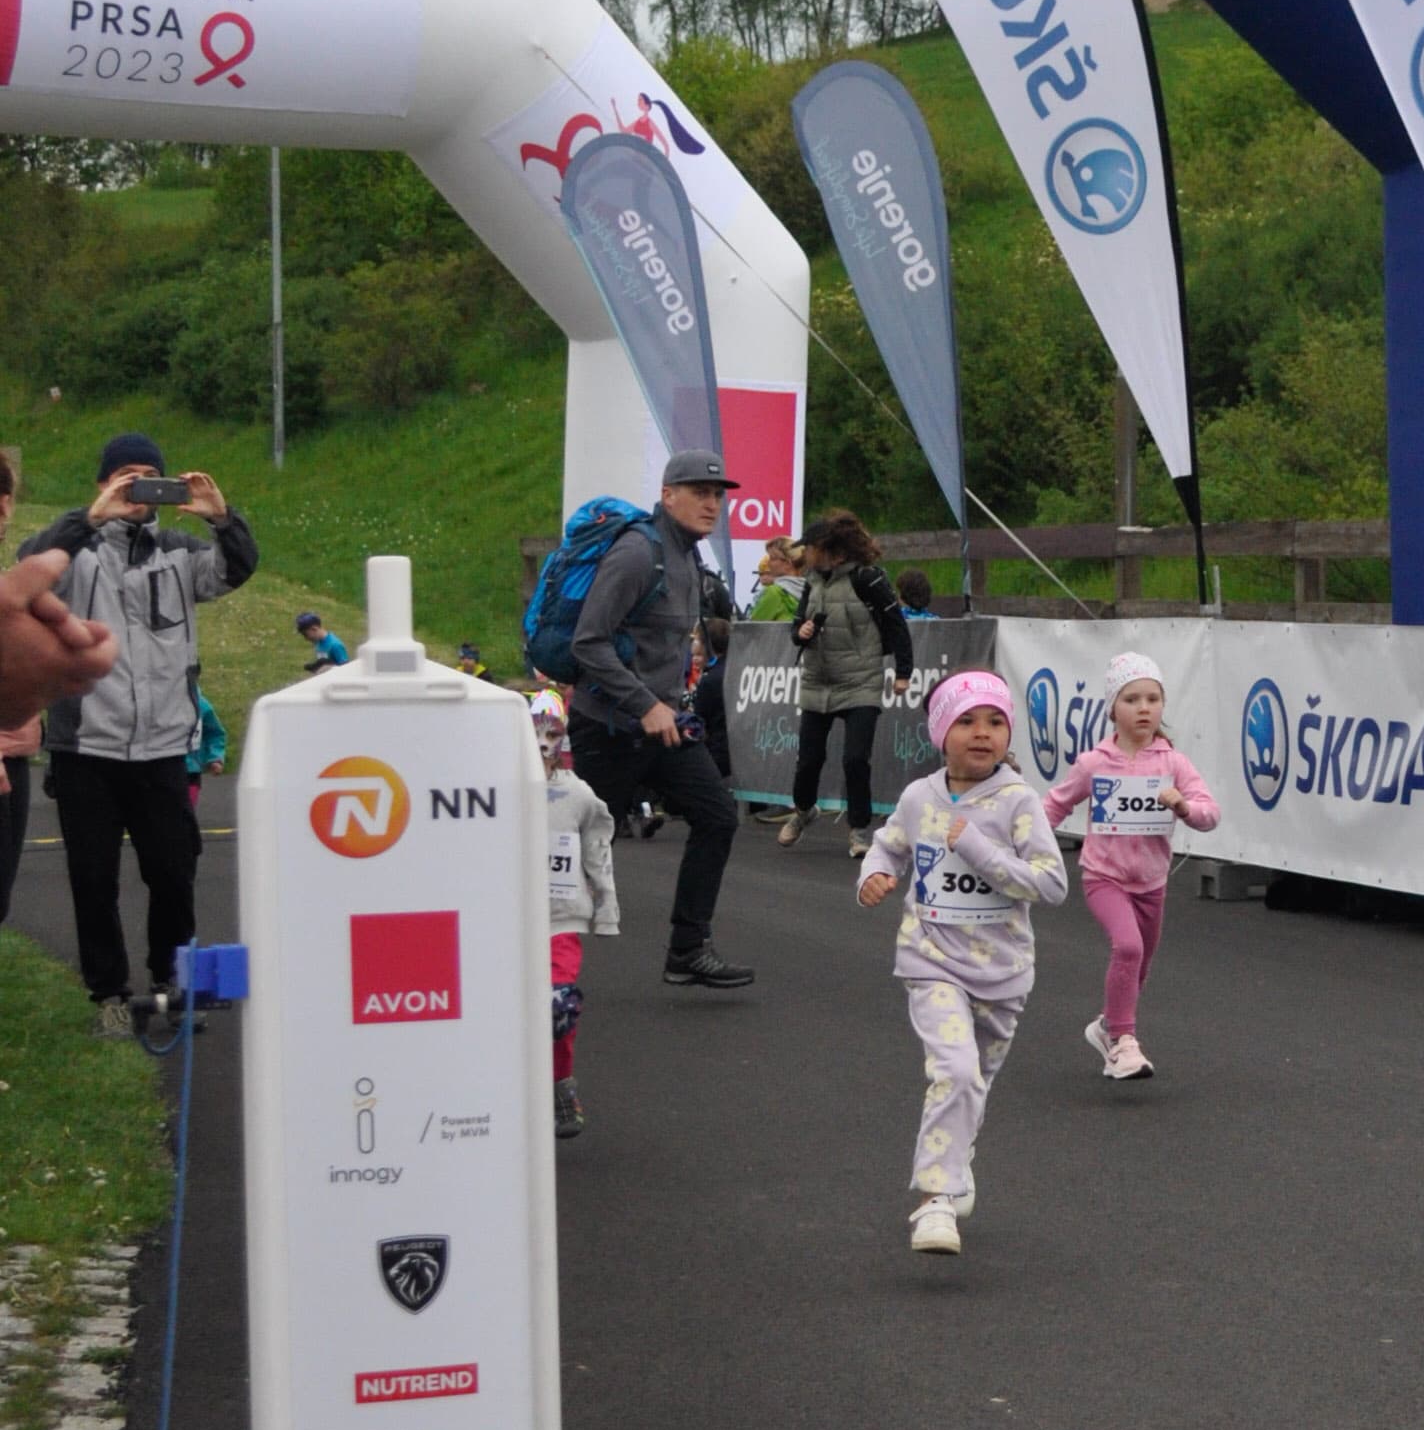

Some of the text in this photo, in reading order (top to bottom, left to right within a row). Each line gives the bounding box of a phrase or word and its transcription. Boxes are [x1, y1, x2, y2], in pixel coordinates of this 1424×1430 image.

[70, 0, 183, 39] PRSA
[62, 45, 184, 83] 2023
[1064, 680, 1107, 765] ŠK
[430, 787, 497, 819] NN
[549, 855, 571, 872] 31
[942, 872, 1000, 895] 303
[364, 991, 449, 1015] AVON
[440, 1114, 490, 1125] Powered
[441, 1130, 456, 1142] by
[330, 1165, 403, 1184] innogy
[361, 1371, 473, 1397] NUTREND
